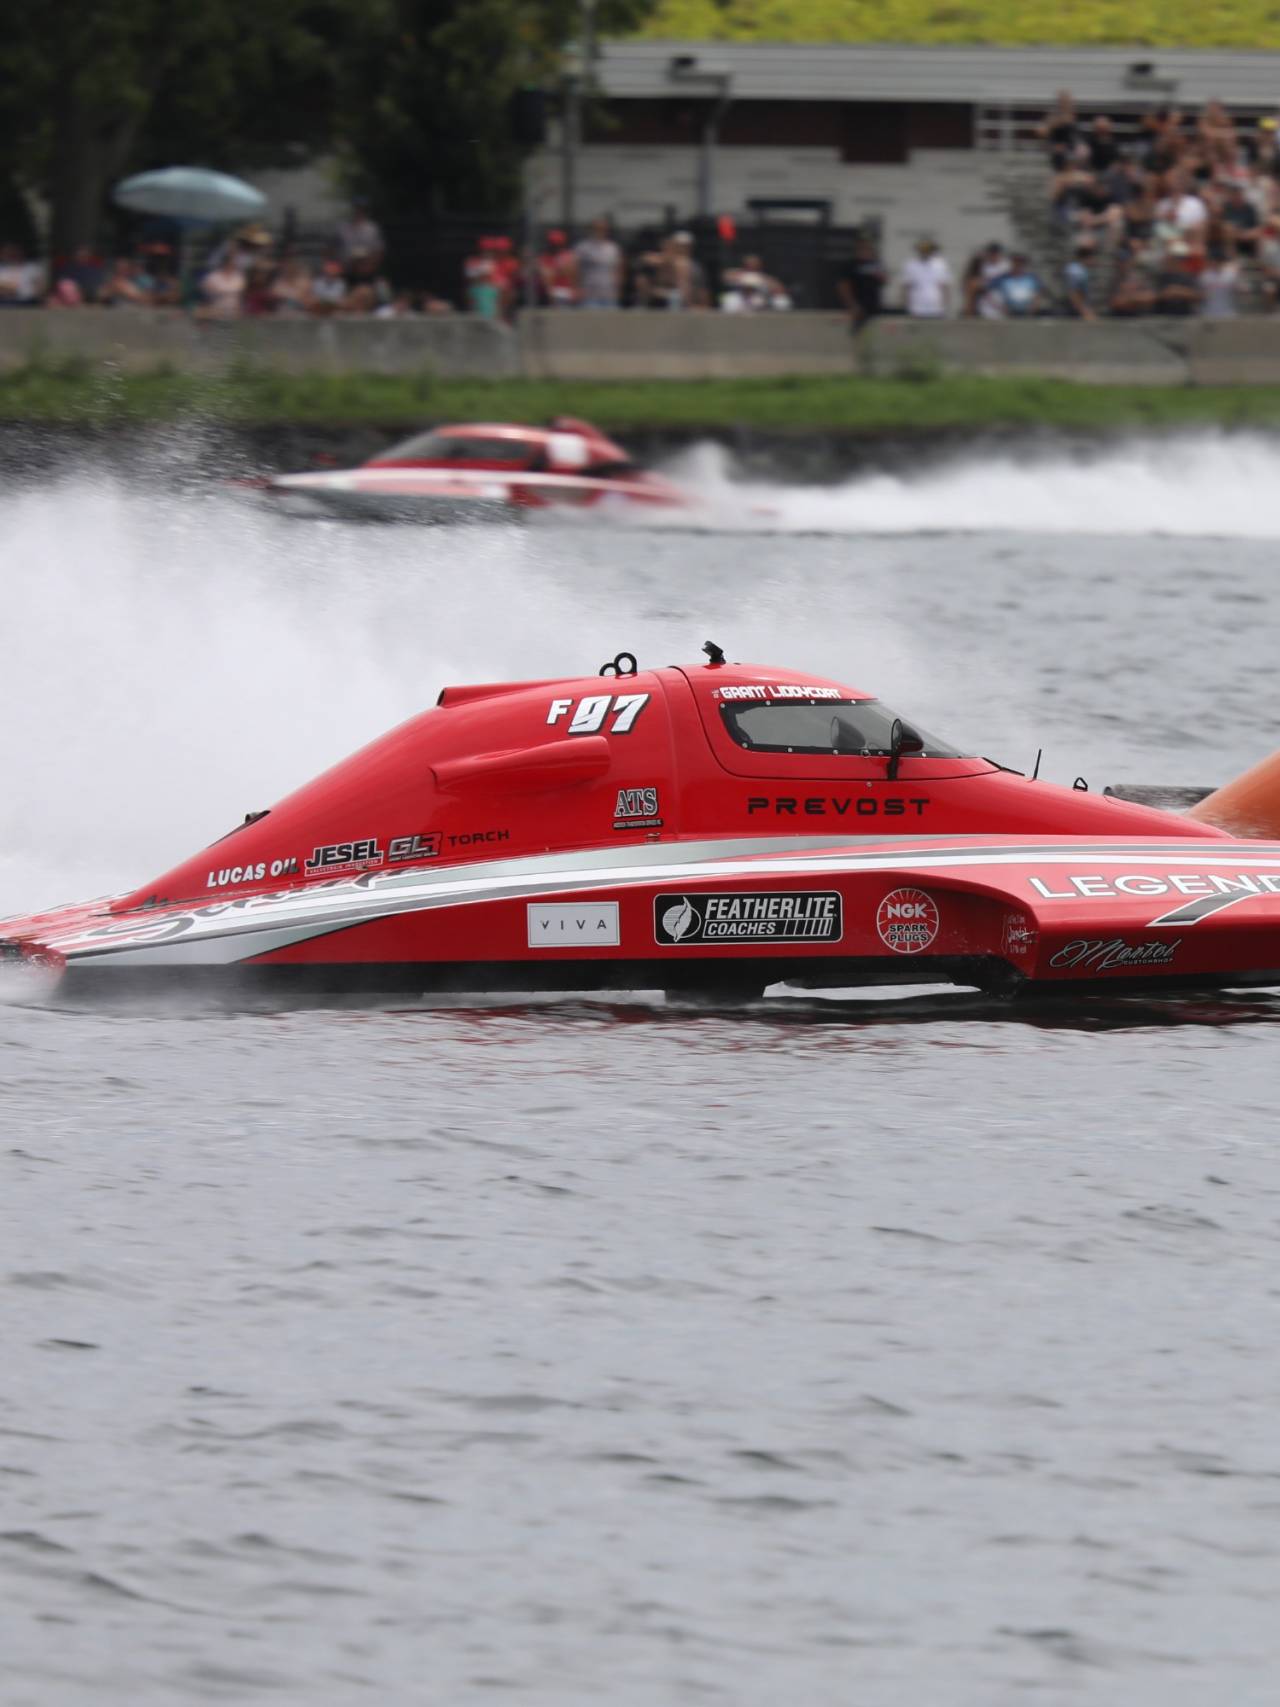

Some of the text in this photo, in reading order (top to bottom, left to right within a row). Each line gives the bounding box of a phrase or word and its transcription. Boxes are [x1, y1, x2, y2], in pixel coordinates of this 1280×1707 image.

[719, 686, 767, 699] GRANT
[614, 787, 658, 817] ATS
[747, 797, 931, 816] PREVOST
[448, 829, 510, 847] TORCH
[304, 838, 383, 868] JESEL
[206, 856, 299, 888] LUCAS OIL
[704, 897, 838, 919] FEATHERLITE
[886, 903, 928, 919] NGK
[540, 919, 607, 931] VIVA
[707, 921, 776, 935] COACHES
[889, 923, 929, 932] SPARK
[889, 932, 929, 942] PLUGS
